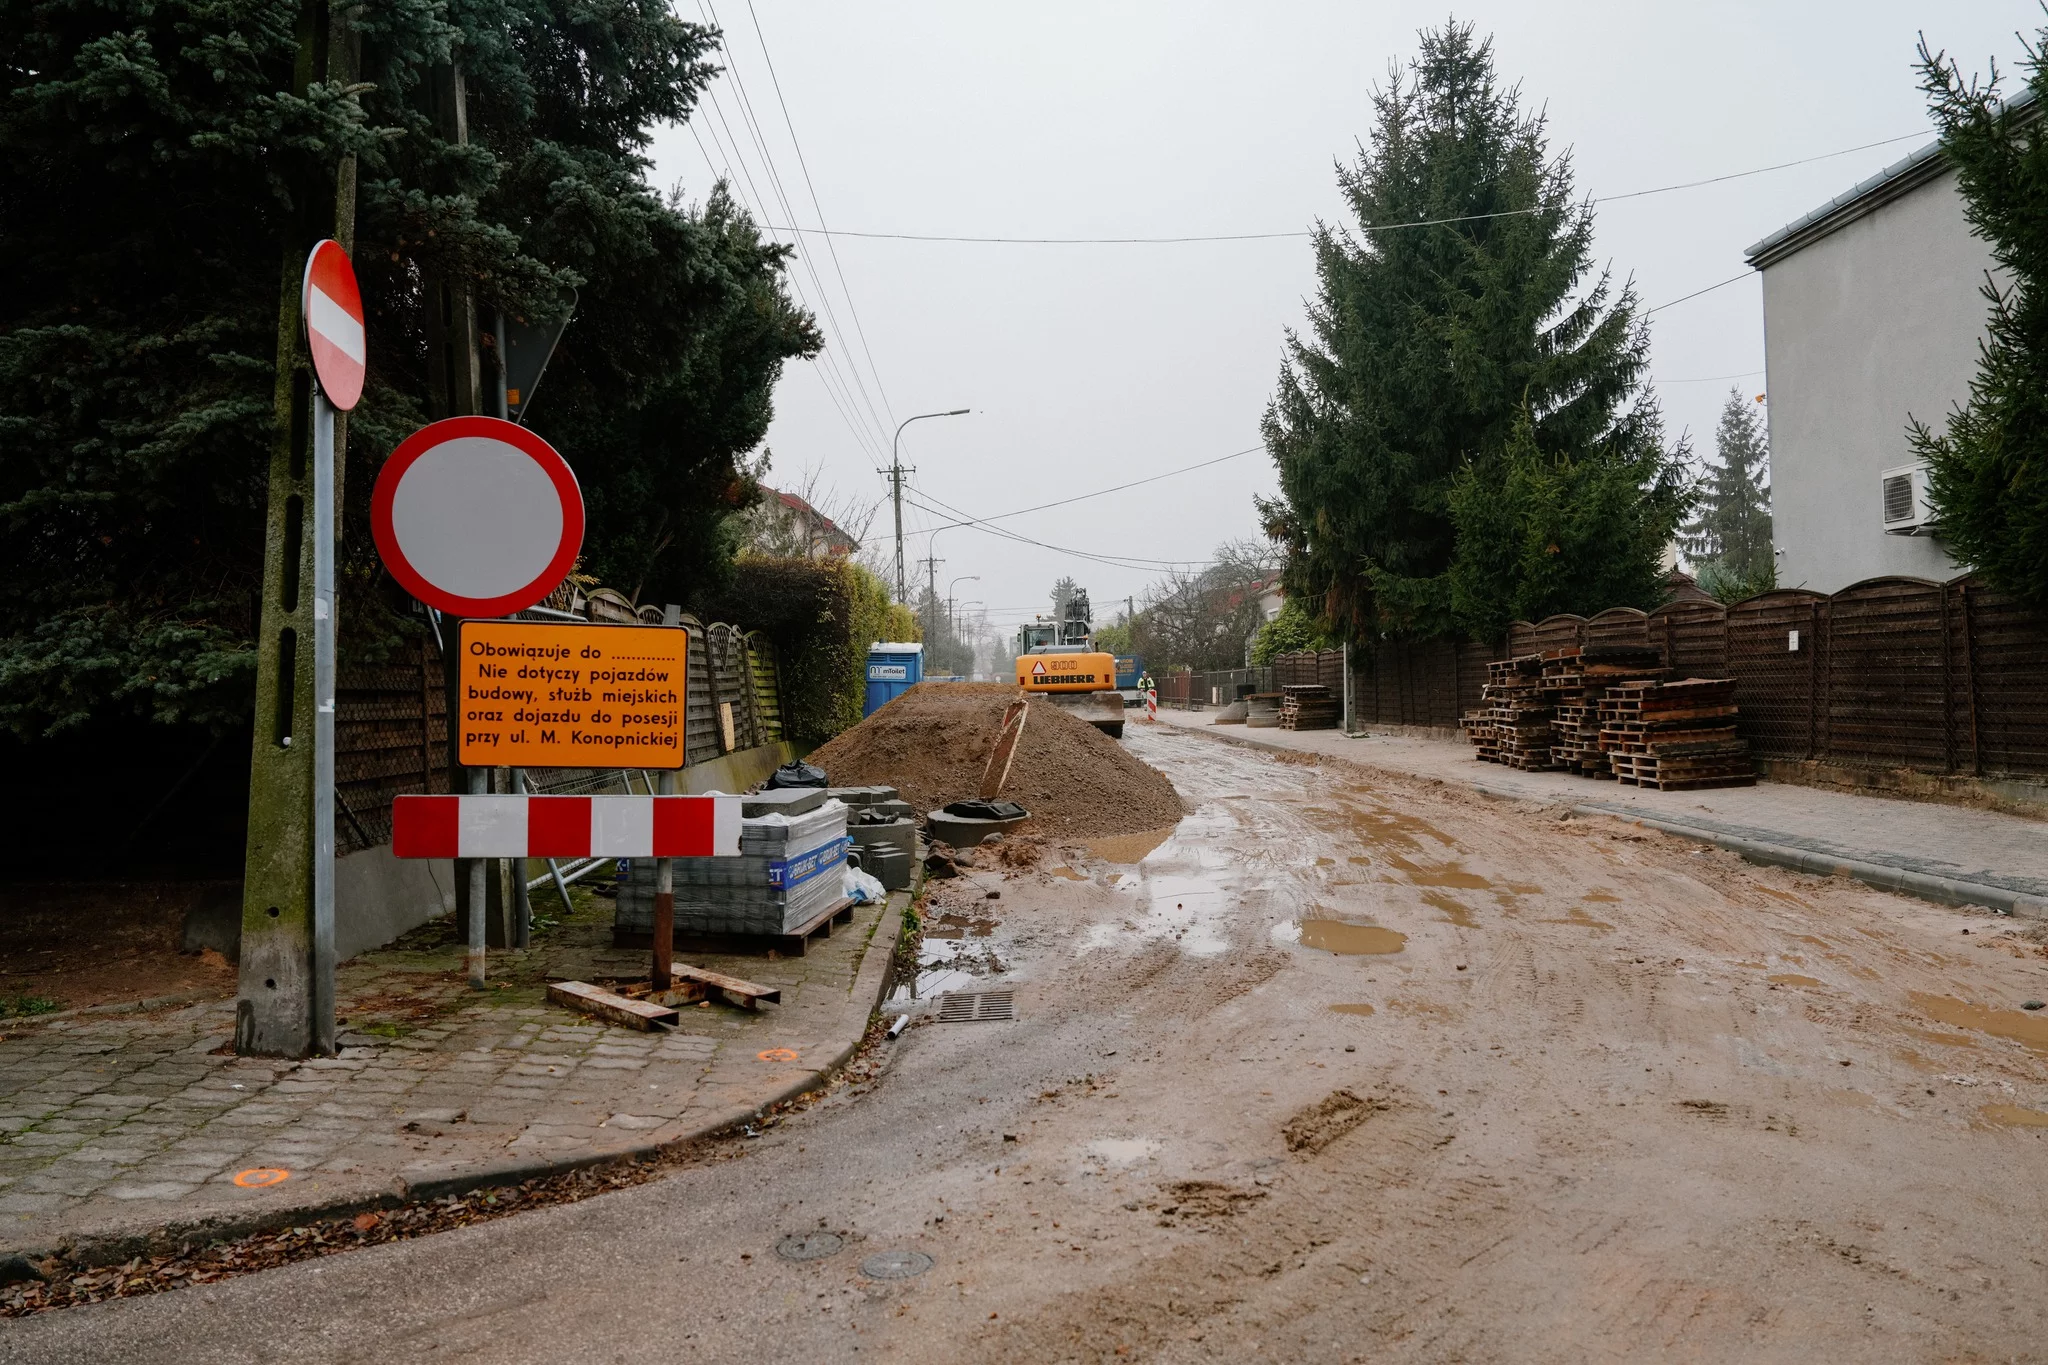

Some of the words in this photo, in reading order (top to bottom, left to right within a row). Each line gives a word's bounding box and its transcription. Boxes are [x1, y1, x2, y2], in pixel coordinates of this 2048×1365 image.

[470, 642, 570, 661] Obowiązuje
[580, 645, 601, 659] do
[479, 664, 507, 678] Nie
[517, 665, 579, 683] dotyczy
[590, 668, 669, 684] pojazdów
[1051, 660, 1077, 670] 900
[1033, 674, 1095, 685] LIEBHERR
[469, 686, 537, 704] budowy,
[549, 688, 592, 702] służb
[603, 689, 677, 706] miejskich
[467, 711, 503, 722] oraz
[513, 708, 580, 725] dojazdu
[591, 710, 611, 723] do
[622, 711, 677, 728] posesji
[466, 732, 500, 747] przy
[510, 730, 530, 744] ul.
[541, 730, 561, 744] M.
[572, 731, 677, 749] Konopnickiej
